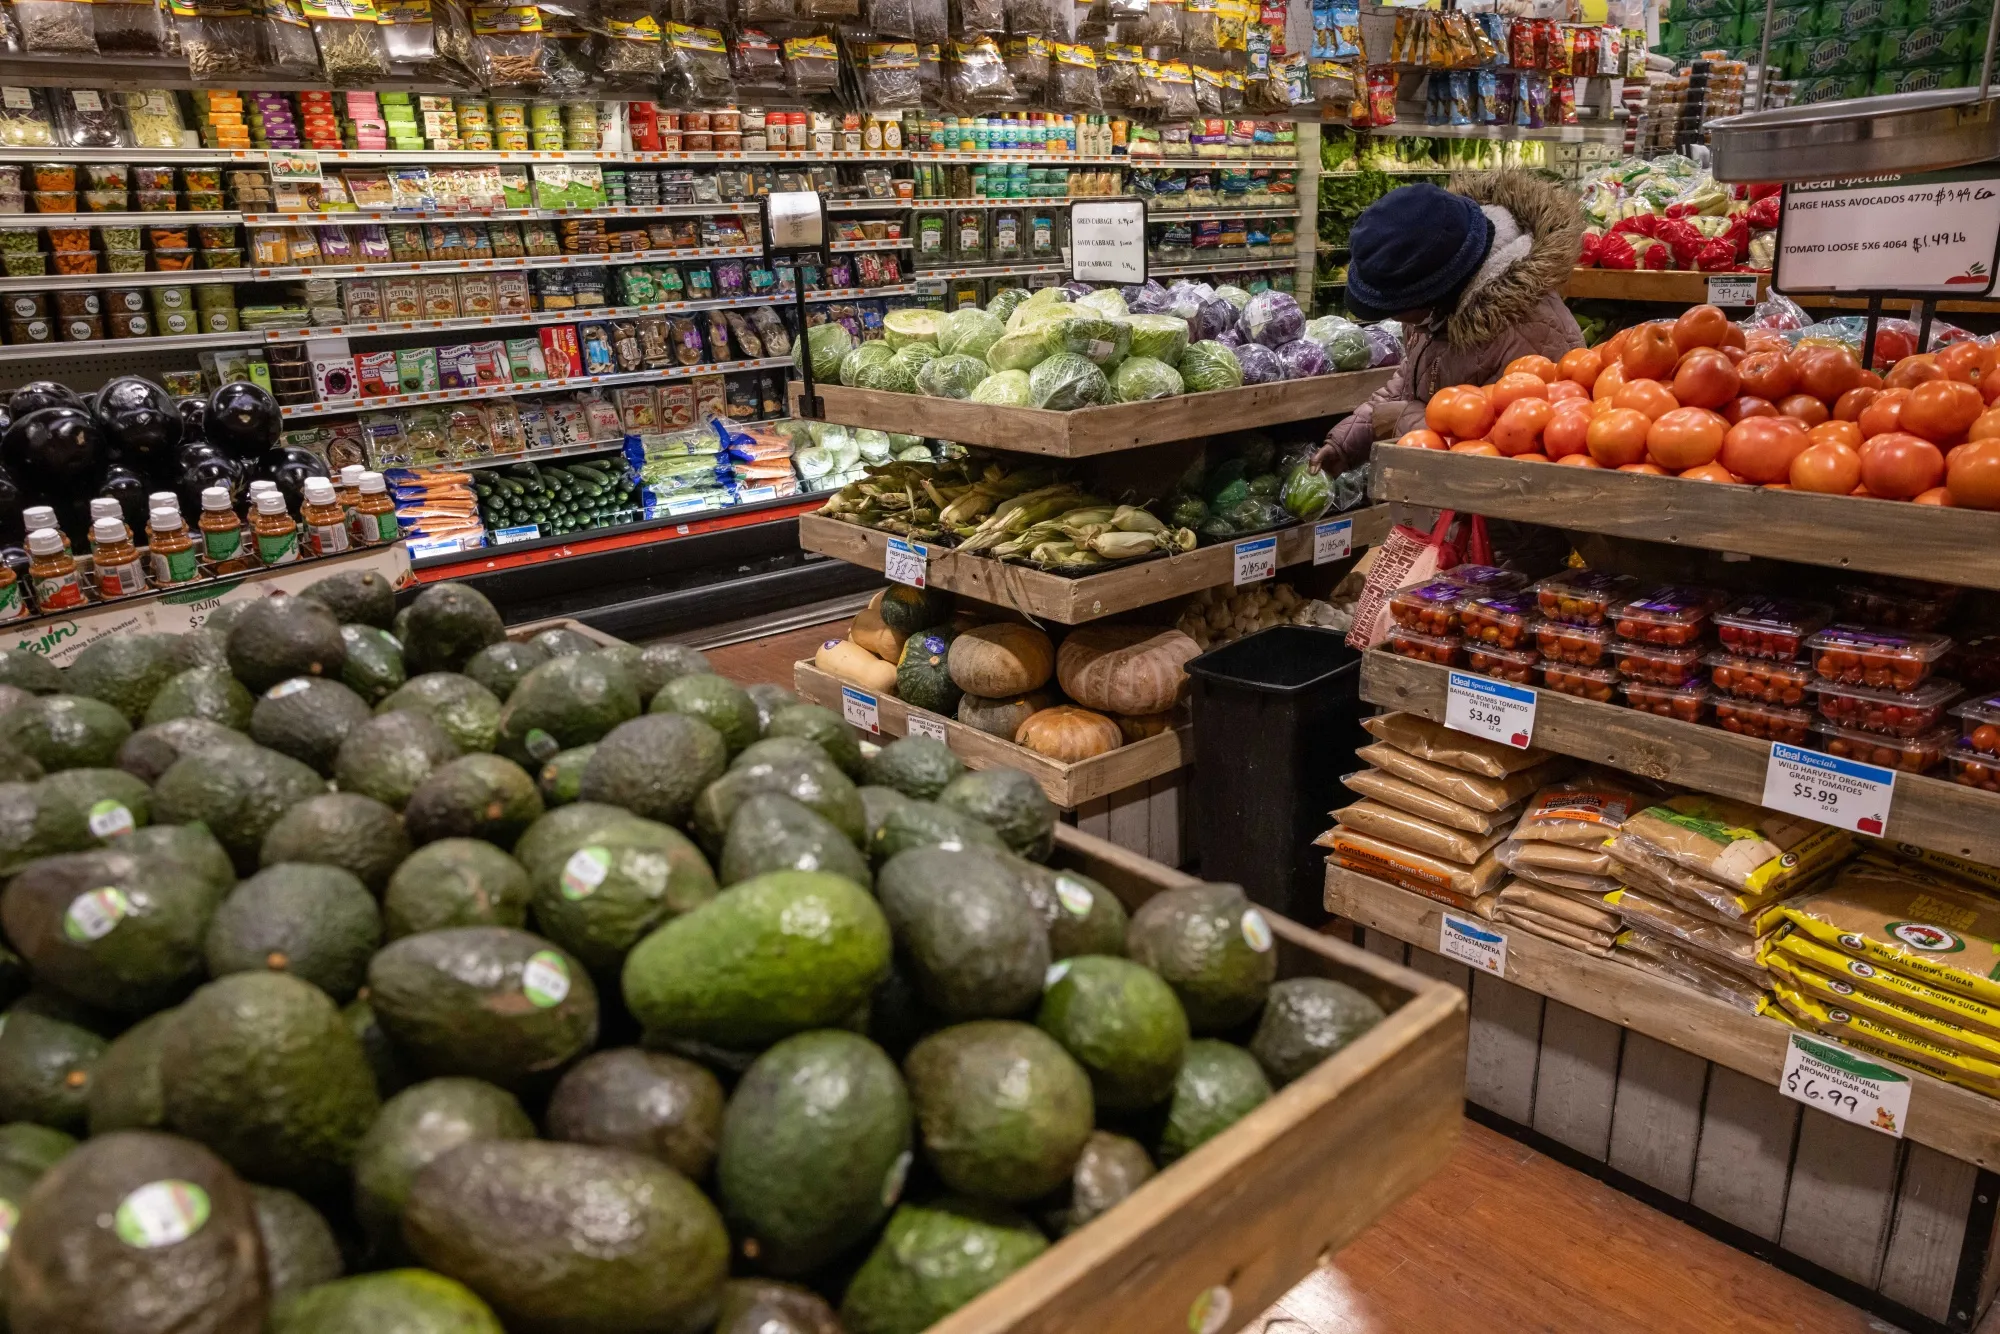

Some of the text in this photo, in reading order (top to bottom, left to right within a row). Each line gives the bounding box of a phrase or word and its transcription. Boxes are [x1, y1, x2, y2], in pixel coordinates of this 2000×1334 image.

[1685, 23, 1721, 47] Bounty
[1807, 32, 1944, 70] Bounty Bounty
[1788, 201, 1818, 211] LARGE
[1821, 199, 1846, 209] HASS
[1848, 195, 1905, 207] AVOCADOS
[1908, 193, 1933, 202] 4770
[1784, 245, 1825, 254] TOMATO
[1827, 242, 1859, 252] LOOSE
[1861, 241, 1880, 250] 5X6
[1882, 239, 1908, 249] 4064
[352, 291, 376, 300] SEITAN
[390, 290, 414, 298] SEITAN
[426, 287, 450, 296] SEITAN
[466, 285, 488, 294] SEITAN
[500, 284, 522, 293] SEITAN
[366, 352, 390, 363] TOFURKY
[405, 348, 429, 360] TOFURKY
[444, 345, 467, 356] TOFURKY
[627, 398, 650, 406] JACKFRUIT
[667, 398, 689, 406] JACKFRUIT
[295, 434, 315, 442] Udon
[49, 641, 87, 661] verything
[87, 630, 111, 644] tastes
[112, 617, 138, 633] better!
[1452, 675, 1496, 692] Ideal Specials
[1450, 687, 1528, 713] BAHAMA BOMBS TOMATOS
[1491, 705, 1505, 713] VINE
[1469, 708, 1501, 726] $3.49
[1776, 746, 1837, 769] Ideal Specials
[1779, 761, 1878, 792] WILD HARVEST ORGANIC
[1789, 771, 1863, 796] GRAPE TOMATOES
[1793, 782, 1838, 805] $5.99
[1338, 843, 1389, 866] Constanzera
[1389, 859, 1417, 875] Brown
[1418, 868, 1444, 883] Sugar
[1929, 853, 1966, 872] NATURAL
[1401, 879, 1456, 904] Brown Sugar
[1445, 929, 1501, 956] LA CONSTANZERA
[1873, 946, 1975, 989] NATURAL BROWN SUGAR
[1883, 974, 1921, 994] NATURAL
[1957, 1000, 1988, 1017] SUGAR
[1862, 991, 1964, 1033] NATURAL BROWN SUGAR
[1858, 1019, 1895, 1039] NATURAL
[1897, 1033, 1928, 1050] BROWN
[1848, 1038, 1885, 1058] NATURAL
[1799, 1064, 1880, 1100] BROWN SUGAR 4Lbs
[1801, 1056, 1881, 1092] TROPIQUE NATURAL
[1787, 1068, 1858, 1115] $6.99
